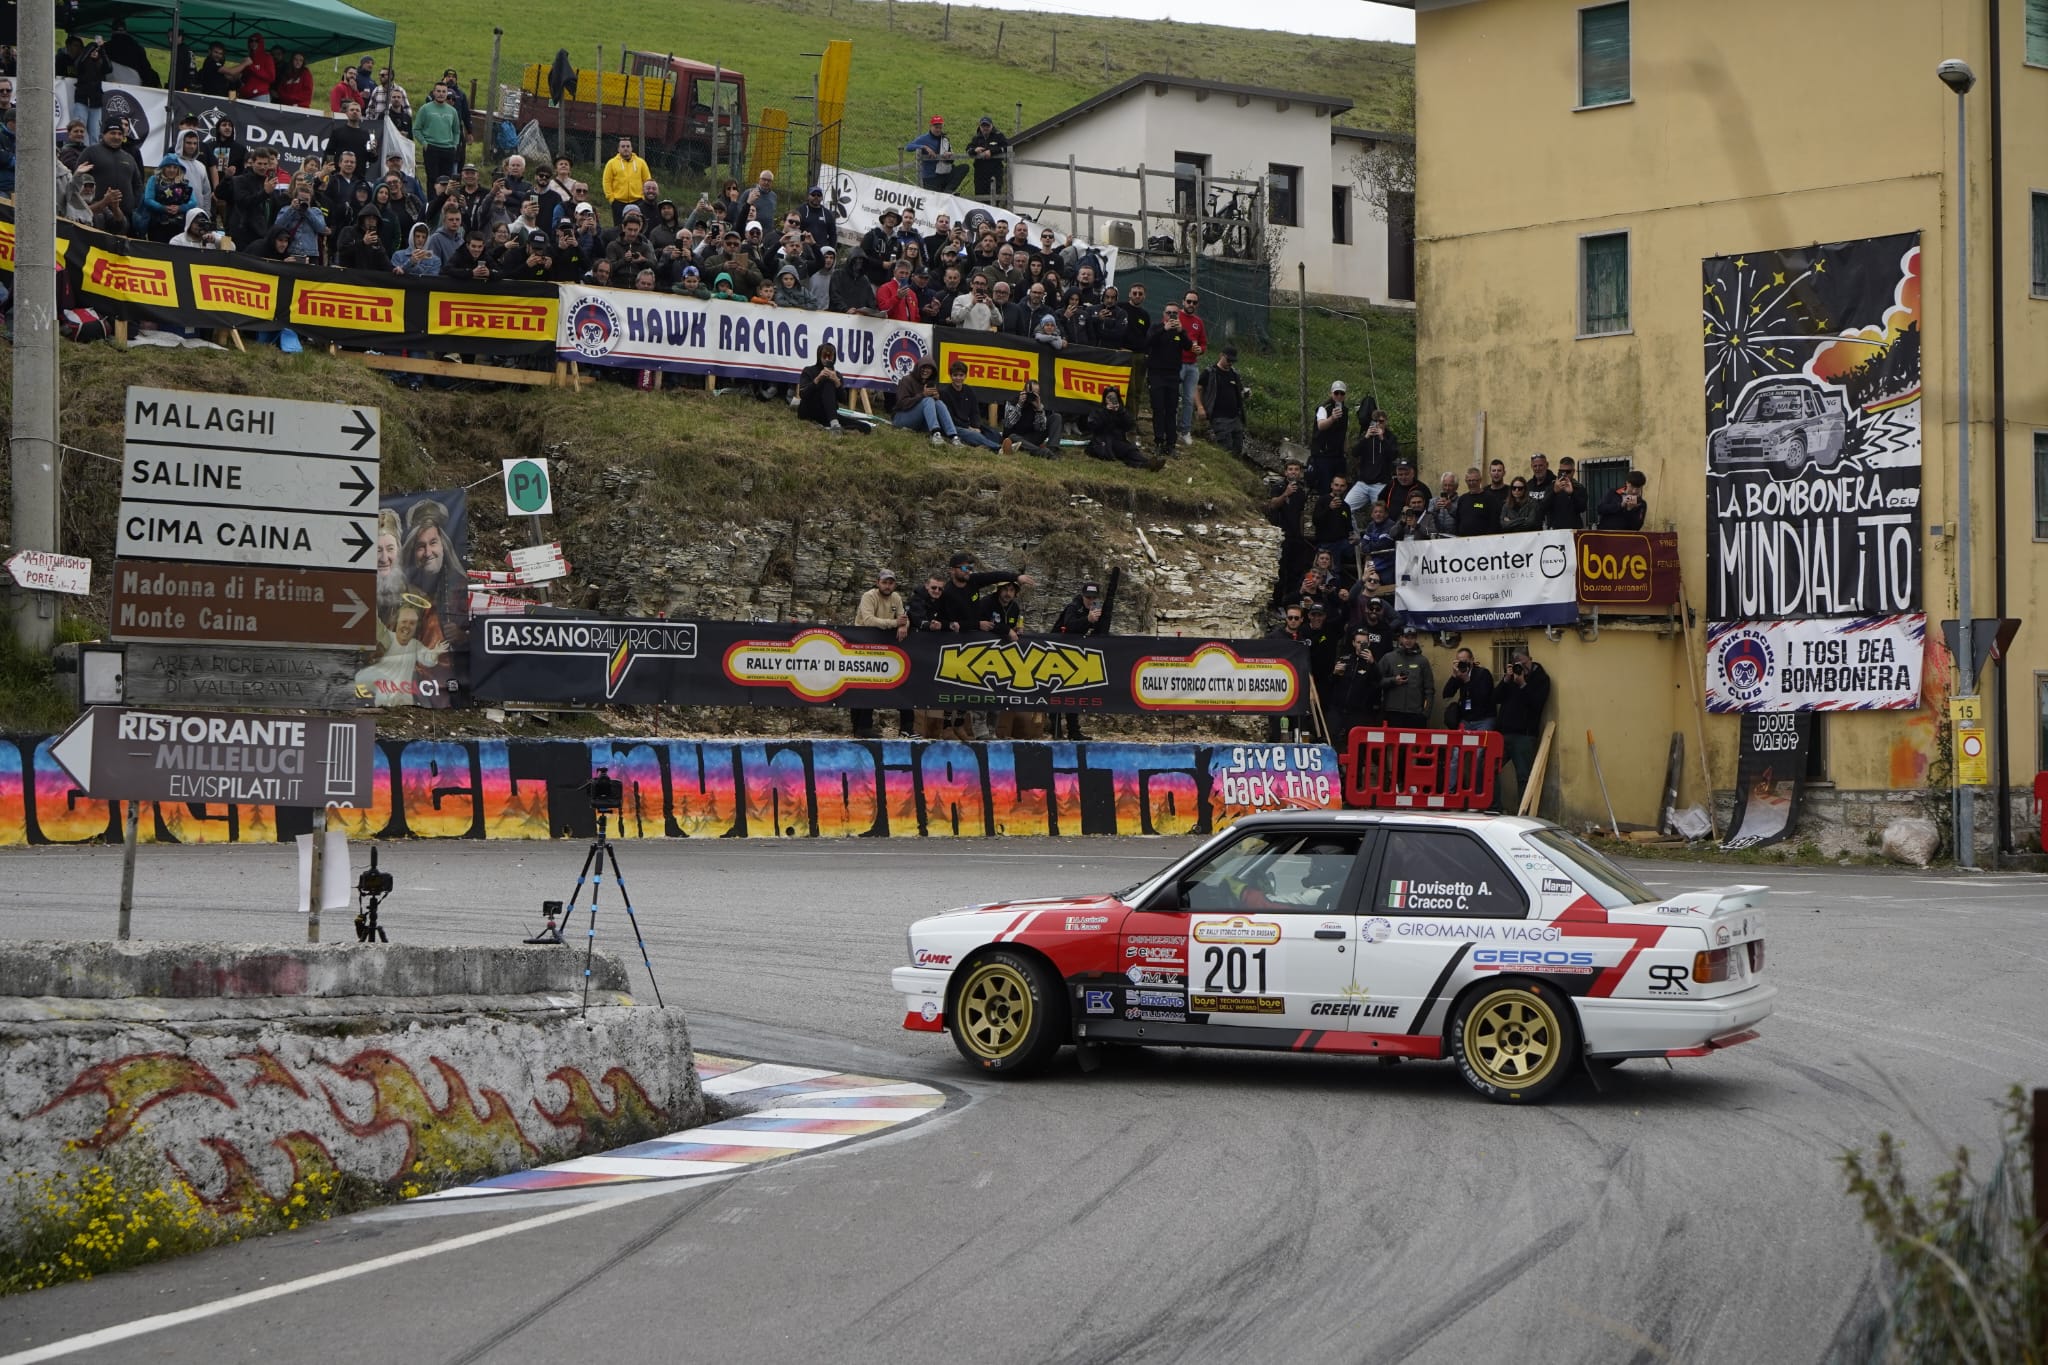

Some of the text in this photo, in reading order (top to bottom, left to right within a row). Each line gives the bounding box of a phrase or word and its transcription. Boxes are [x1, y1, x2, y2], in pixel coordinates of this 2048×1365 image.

[874, 188, 925, 211] BIOLINE
[91, 258, 168, 297] PIRELLI
[199, 274, 271, 311] PIRELLI
[298, 289, 394, 323] PIRELLI
[439, 301, 548, 332] PIRELLI
[567, 297, 619, 357] HAWK RACING CLUB
[627, 307, 875, 365] HAWK RACING CLUB
[883, 331, 929, 369] HAWK RACIN
[948, 352, 1031, 384] PRELLI
[135, 400, 275, 435] MALAGHI
[131, 460, 242, 490] SALINE
[514, 473, 543, 500] P1
[1717, 474, 1916, 518] LA BOMBONERA DEL
[126, 517, 312, 551] CIMA CAINA
[25, 552, 86, 569] AGRITURISMO
[1421, 550, 1534, 575] Autocenter
[1583, 544, 1648, 580] base
[26, 571, 54, 583] PORTE
[122, 571, 325, 602] Madonna di Fatima
[1583, 582, 1648, 592] bassano serramenti
[1460, 591, 1471, 601] del
[1472, 591, 1500, 603] Grappa
[120, 603, 258, 632] Monte Caina
[1427, 609, 1522, 624] www.autocentervolvo.com
[152, 656, 316, 674] AREA RICREATIVA
[747, 657, 889, 673] RALLY CITTA' DI BASSANO
[1718, 630, 1775, 701] HAWK RACING CLUB
[1787, 638, 1896, 666] I TOSI DEA
[937, 643, 1106, 690] KAYAK
[1781, 664, 1911, 693] BOMBONERA
[167, 679, 304, 697] DI VALLERANA
[1142, 676, 1288, 693] RALLY STORICO CITTA' DI BASSANO
[938, 694, 1103, 706] SPORTGLASSES
[1958, 705, 1974, 719] 15
[118, 715, 306, 747] RISTORANTE
[1758, 713, 1795, 732] DOVE
[1753, 732, 1799, 751] VAEO?
[155, 743, 305, 775] MILLELUCI
[1229, 746, 1322, 773] give us
[169, 775, 304, 801] ELVISPILATI.IT
[1222, 768, 1330, 806] back the
[1409, 880, 1493, 896] Lovisetto A.
[1543, 879, 1572, 893] Maran
[1408, 895, 1470, 910] Cracco C.
[1398, 922, 1495, 939] GIROMANIA
[1502, 926, 1560, 941] VIAGGI
[1204, 946, 1266, 995] 201
[1473, 950, 1593, 965] GEROS
[1538, 966, 1590, 974] engineering
[1648, 965, 1689, 992] SR
[1194, 995, 1216, 1005] base
[1259, 997, 1281, 1007] base
[1310, 1003, 1399, 1019] GREEN LINE
